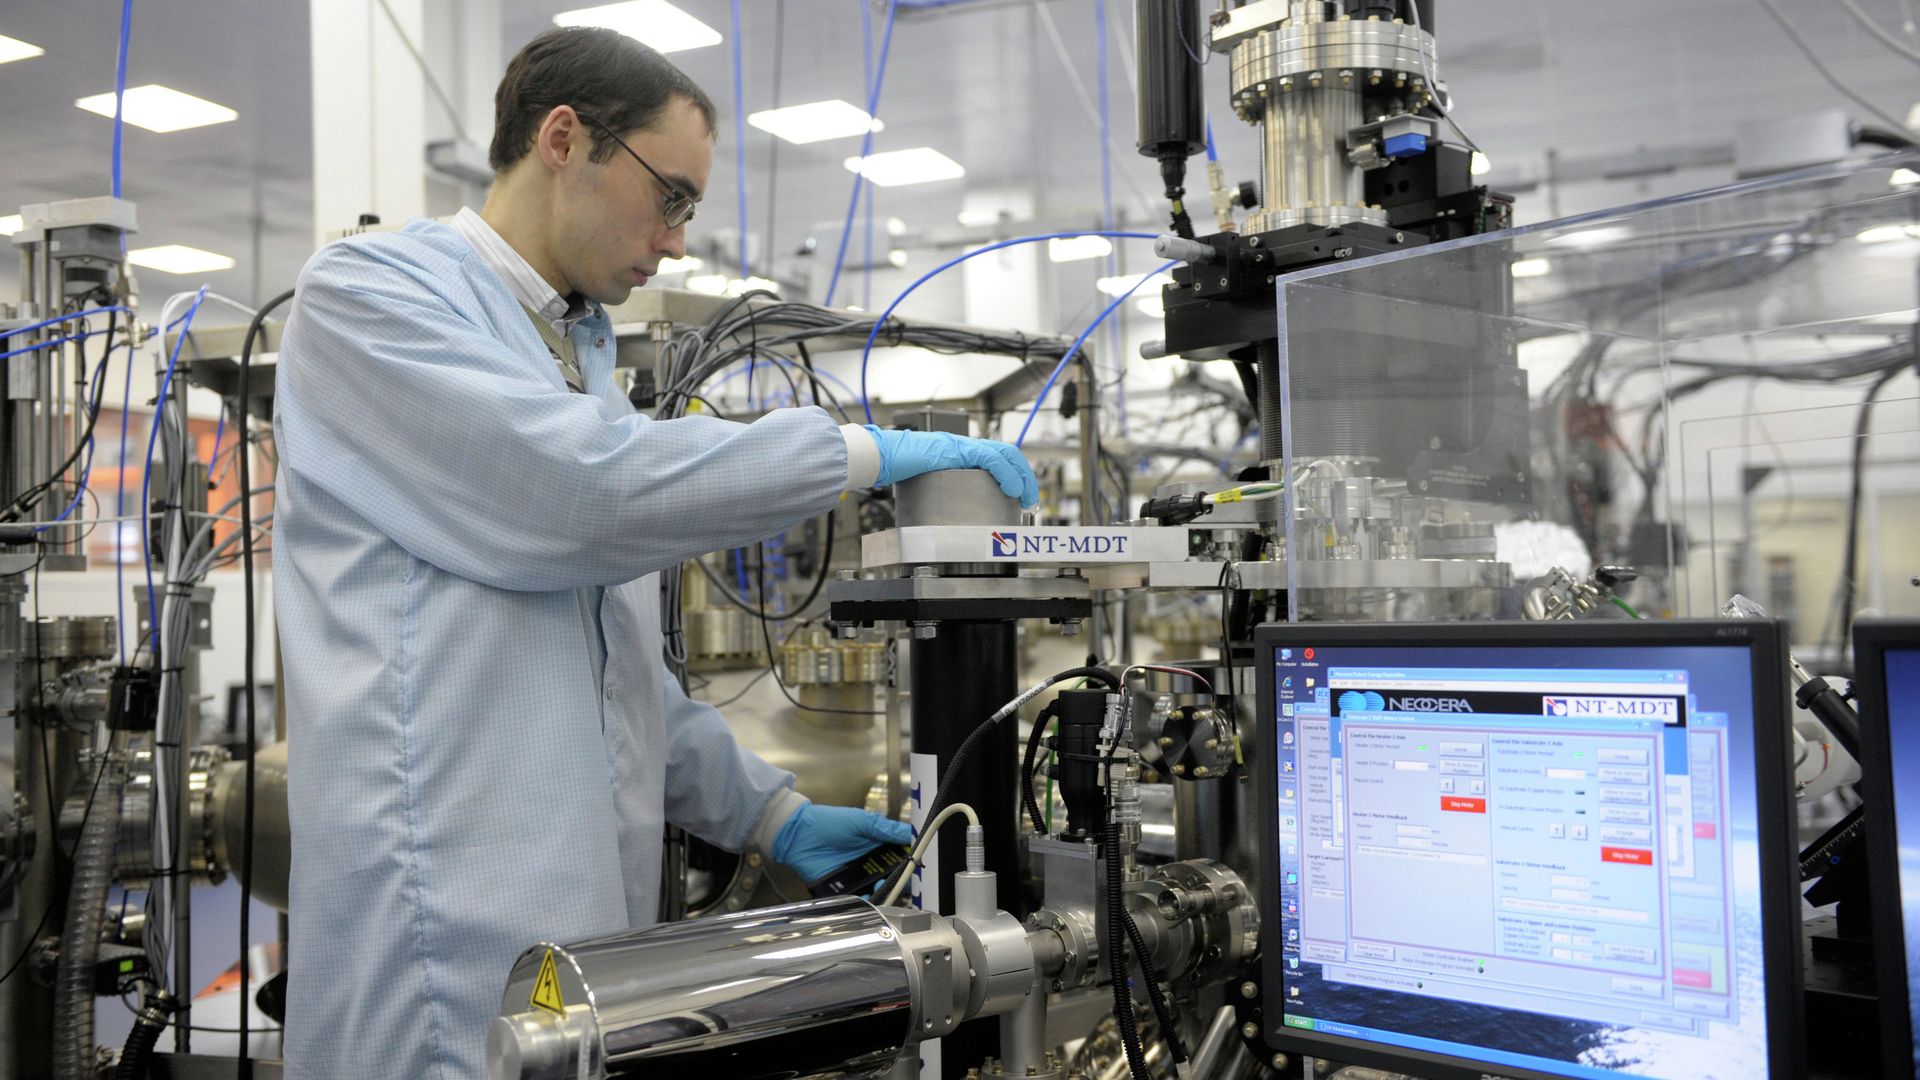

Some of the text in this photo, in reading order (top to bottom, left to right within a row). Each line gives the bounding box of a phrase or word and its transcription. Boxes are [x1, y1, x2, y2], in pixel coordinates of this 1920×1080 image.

[1022, 535, 1128, 553] NT-MDT
[1388, 696, 1474, 713] NEOCERA
[1575, 699, 1673, 716] NT-MDT
